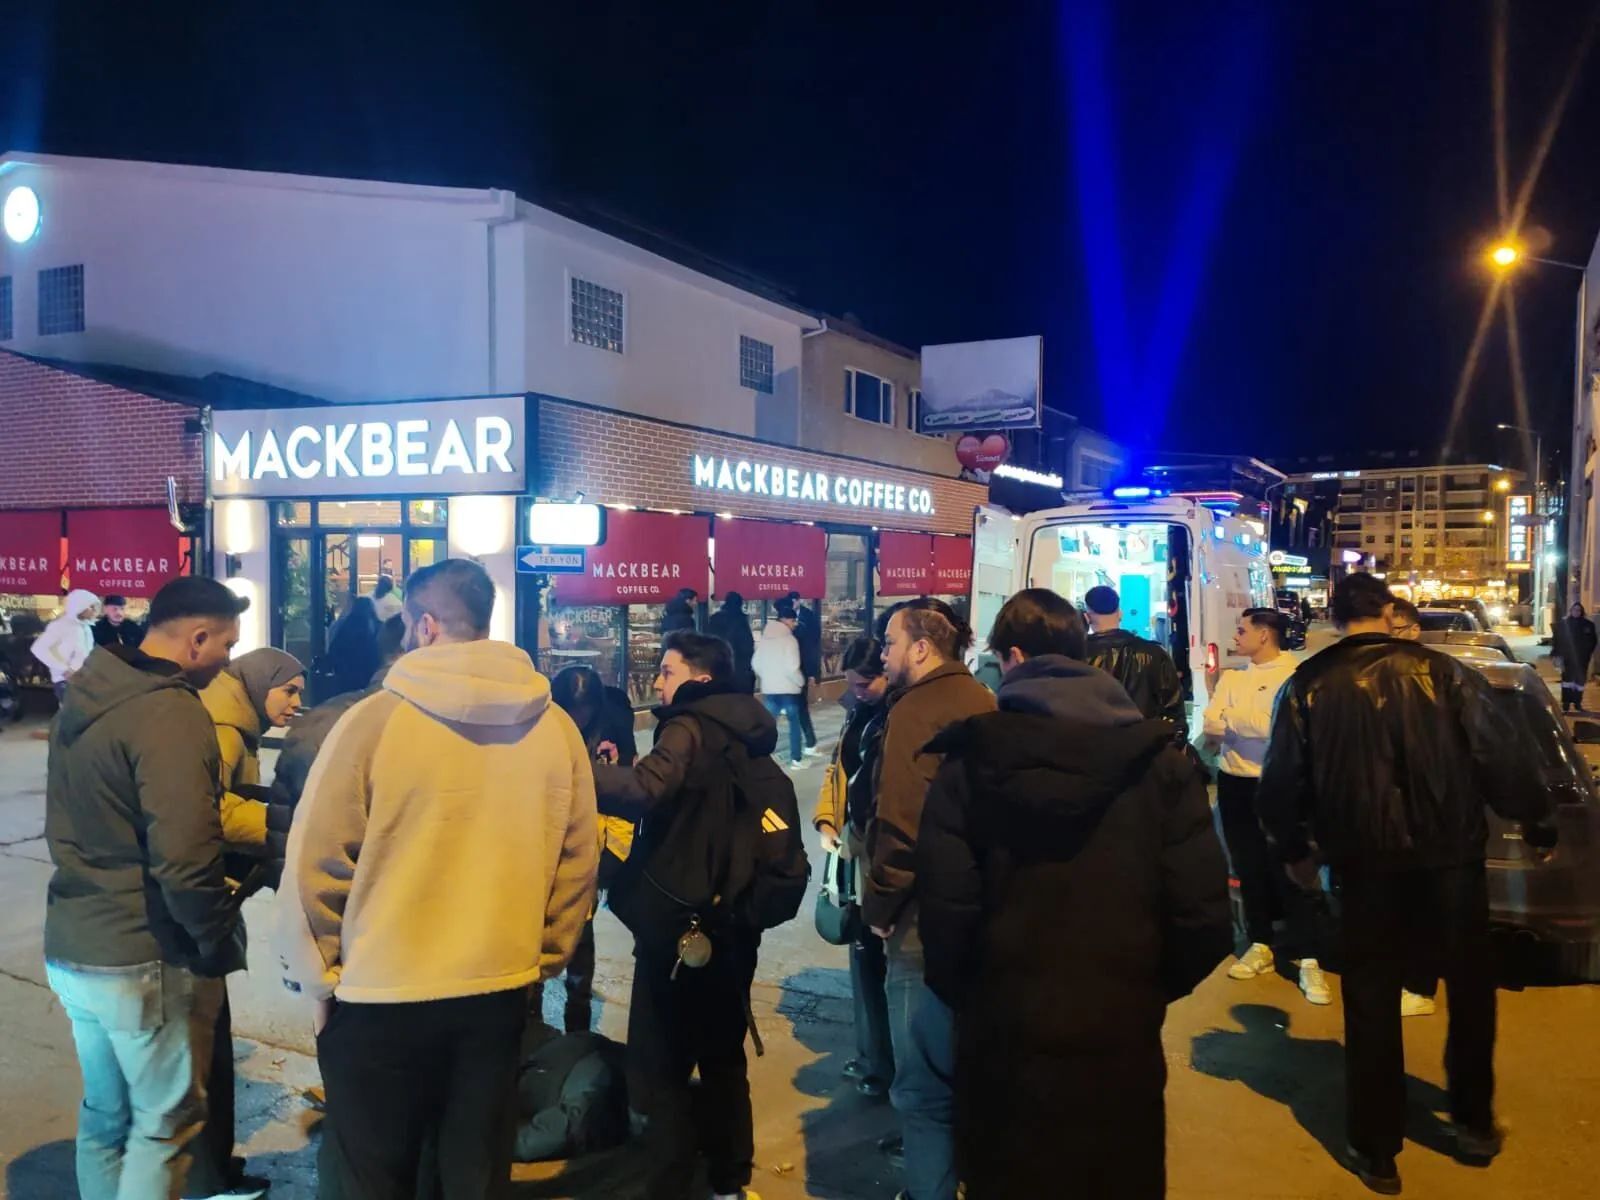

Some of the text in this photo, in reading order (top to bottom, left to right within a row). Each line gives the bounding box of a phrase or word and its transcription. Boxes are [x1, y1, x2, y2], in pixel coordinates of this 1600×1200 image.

[213, 416, 514, 481] MACKBEAR
[693, 454, 936, 515] MACKBEAR COFFEE CO.
[75, 558, 168, 572] MACKBEAR
[592, 562, 681, 578] MACKBEAR
[741, 564, 805, 577] MACKBEAR
[886, 567, 927, 578] MACKBEAR
[99, 578, 132, 588] COFFEE
[616, 585, 648, 594] COFFEE
